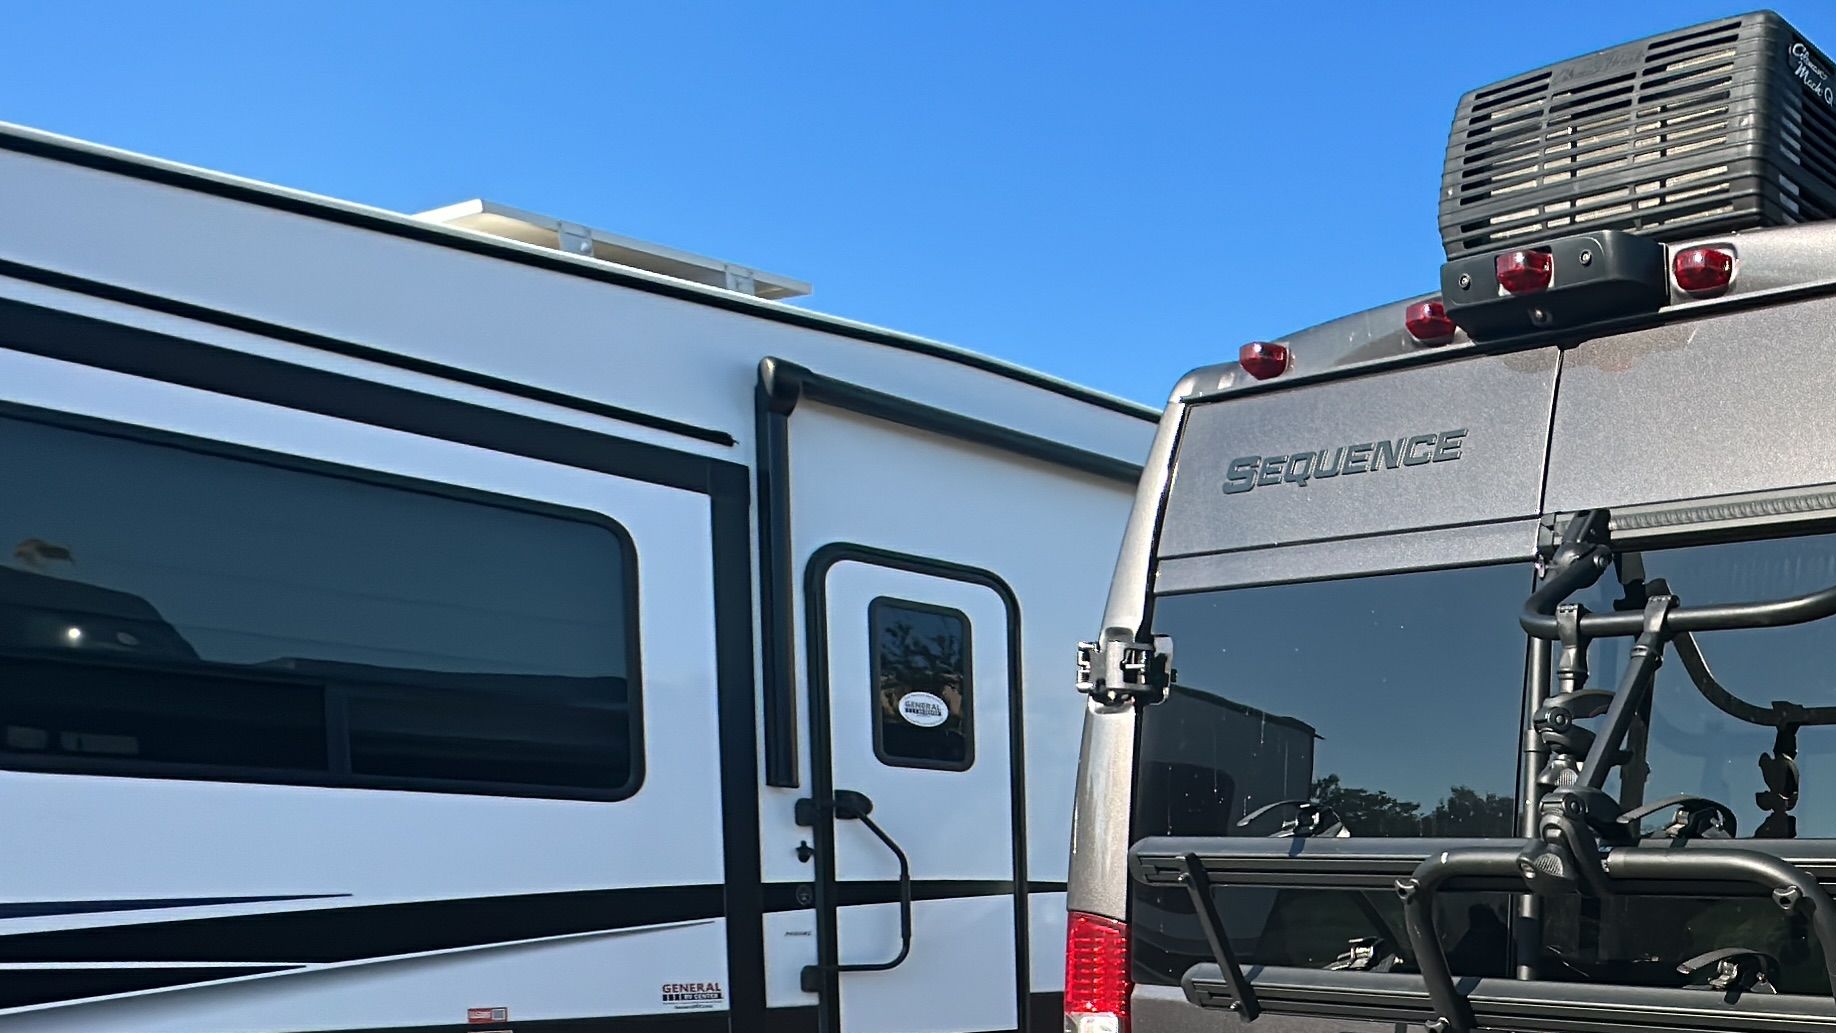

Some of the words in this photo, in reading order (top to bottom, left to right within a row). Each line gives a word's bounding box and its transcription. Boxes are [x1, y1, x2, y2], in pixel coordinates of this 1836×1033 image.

[1824, 87, 1833, 107] Q
[1222, 428, 1468, 494] SEQUENCE
[662, 983, 722, 993] GENERAL
